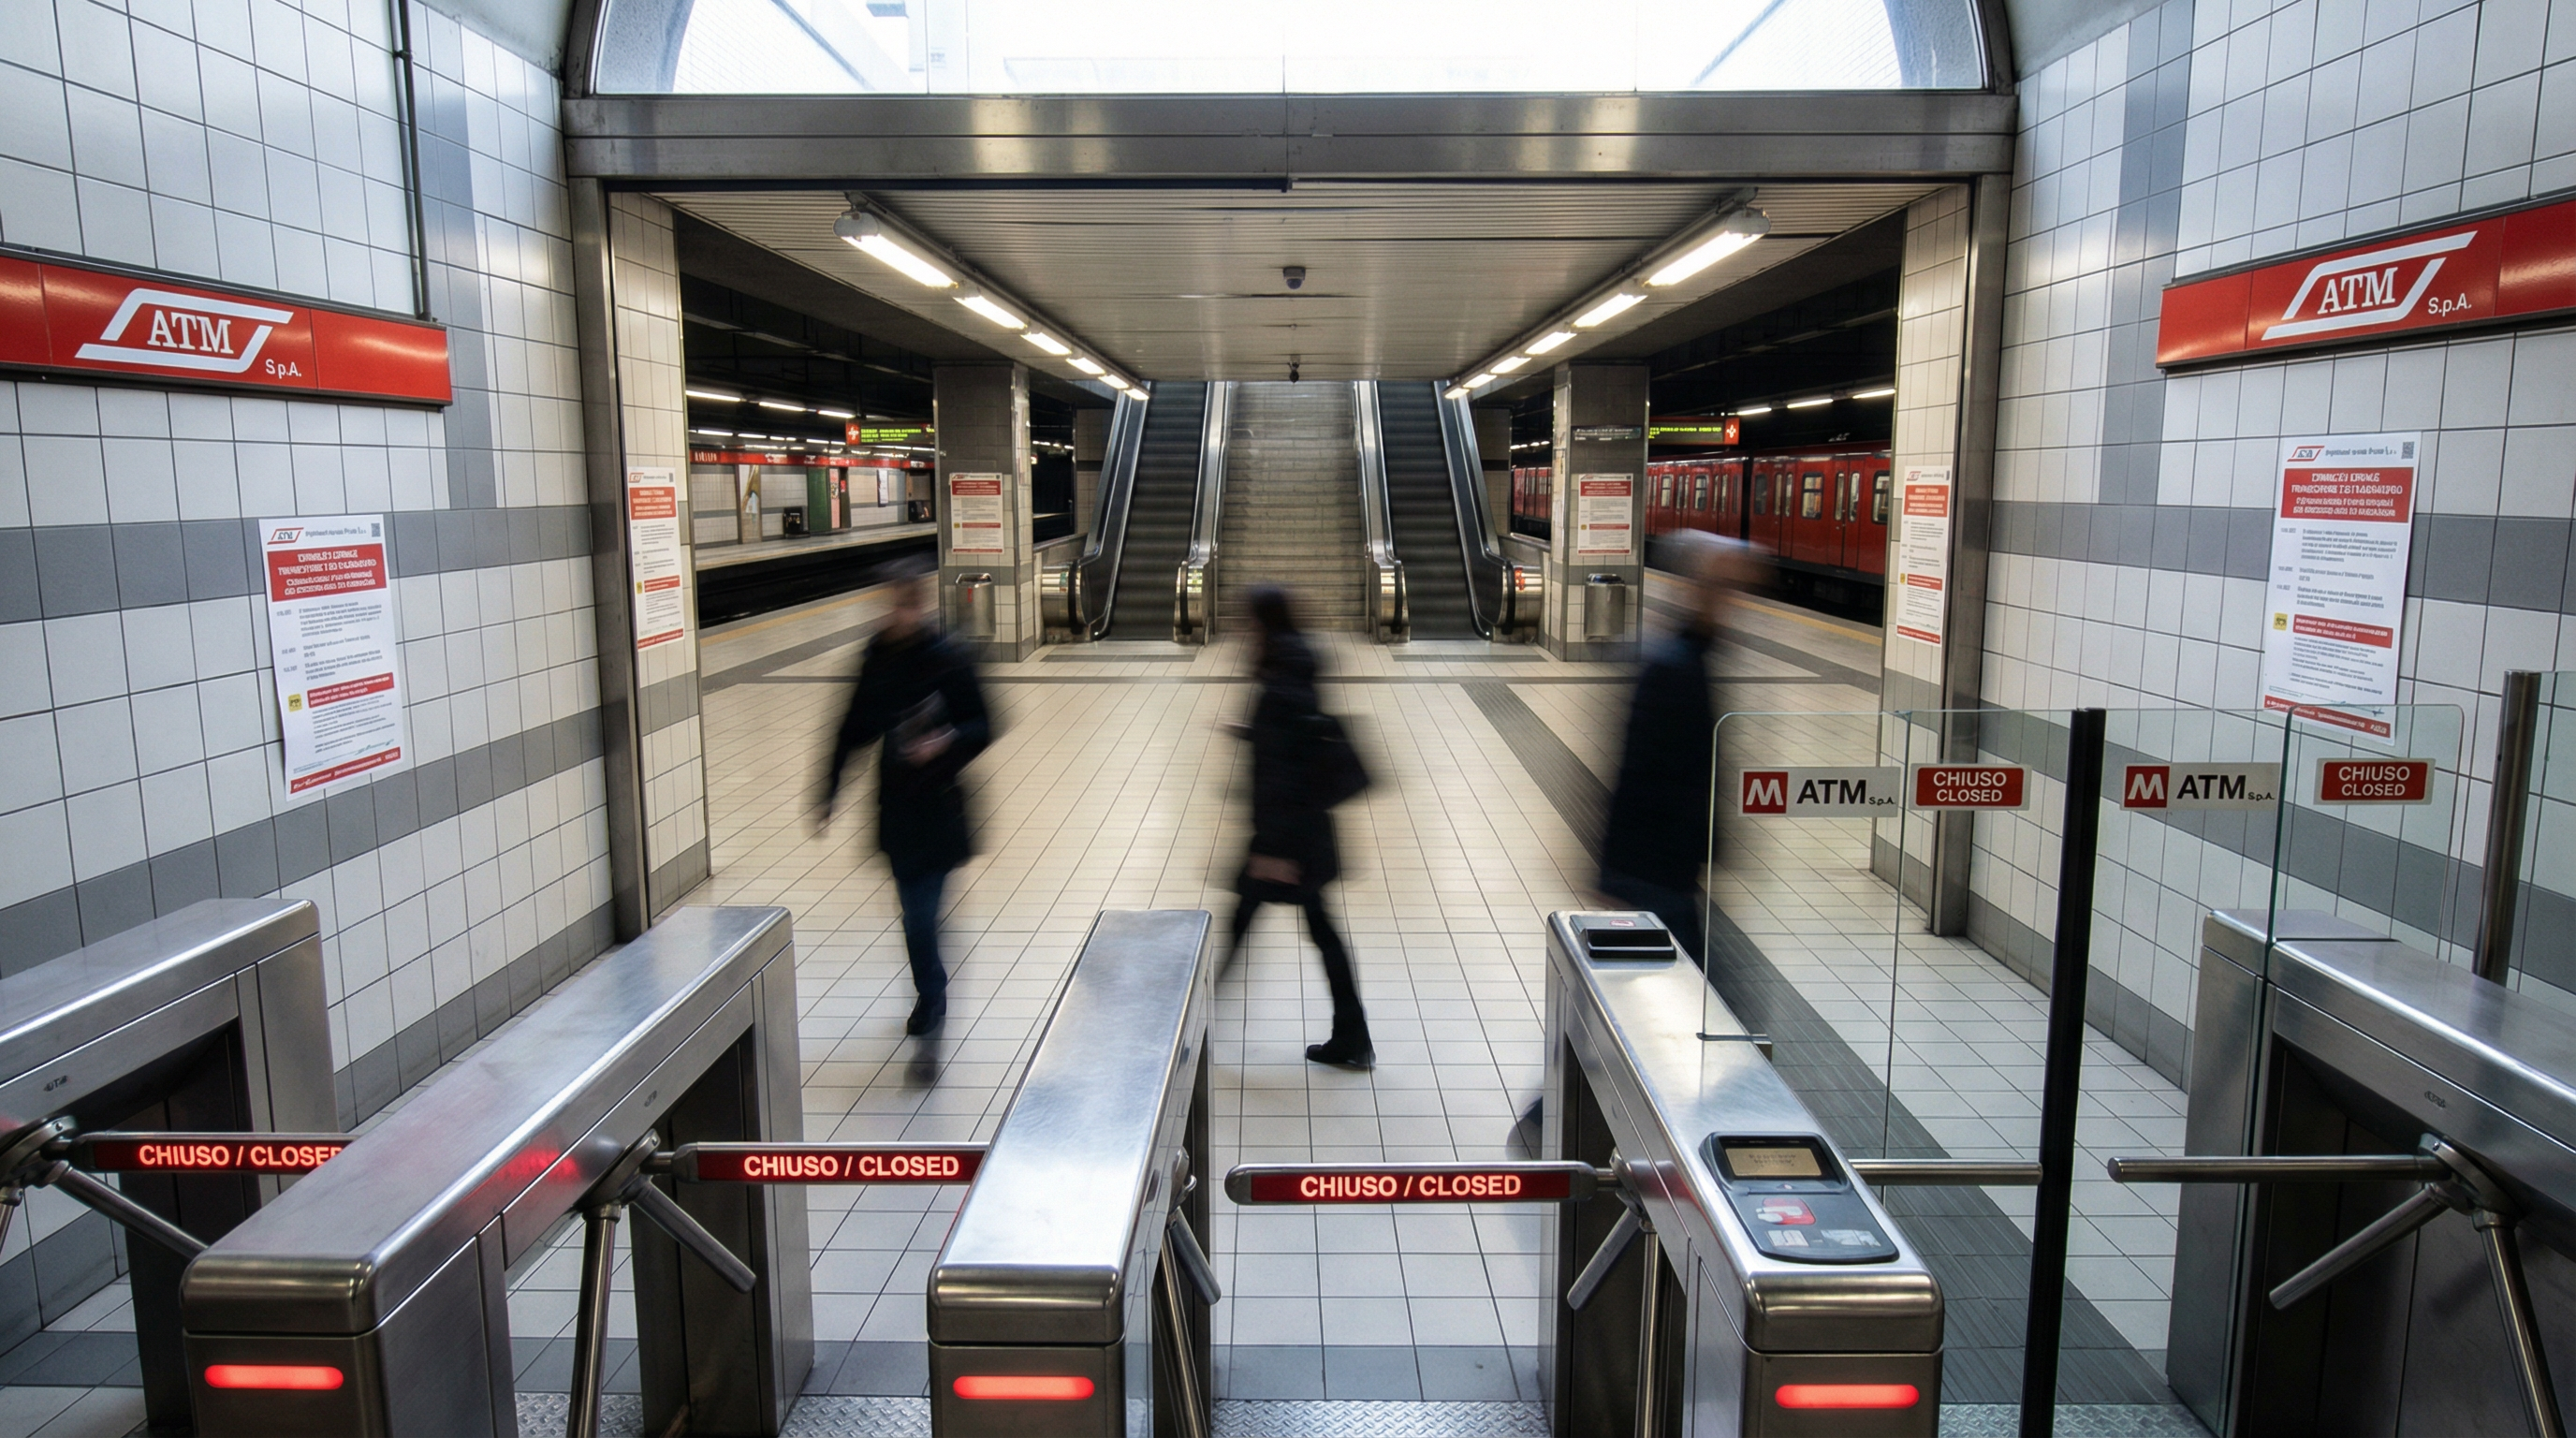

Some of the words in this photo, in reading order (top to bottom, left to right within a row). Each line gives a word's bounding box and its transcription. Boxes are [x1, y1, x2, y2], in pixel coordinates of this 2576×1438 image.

[2317, 267, 2398, 315] ATM
[2427, 293, 2472, 316] S.p.A.
[147, 310, 234, 354] ATM
[1933, 771, 2007, 786] CHIUSO
[2339, 766, 2410, 782] CHIUSO
[1796, 779, 1866, 804] ATM
[1936, 789, 2003, 802] CLOSED
[2176, 774, 2247, 800] ATM
[2341, 784, 2406, 796] CLOSED
[139, 1145, 229, 1166] CHIUSO
[236, 1146, 244, 1167] /
[744, 1155, 839, 1176] CHIUSO
[844, 1156, 853, 1177] /
[858, 1156, 959, 1176] CLOSED
[1300, 1176, 1398, 1197] CHIUSO
[1403, 1176, 1413, 1197] /
[1419, 1175, 1521, 1196] CLOSED
